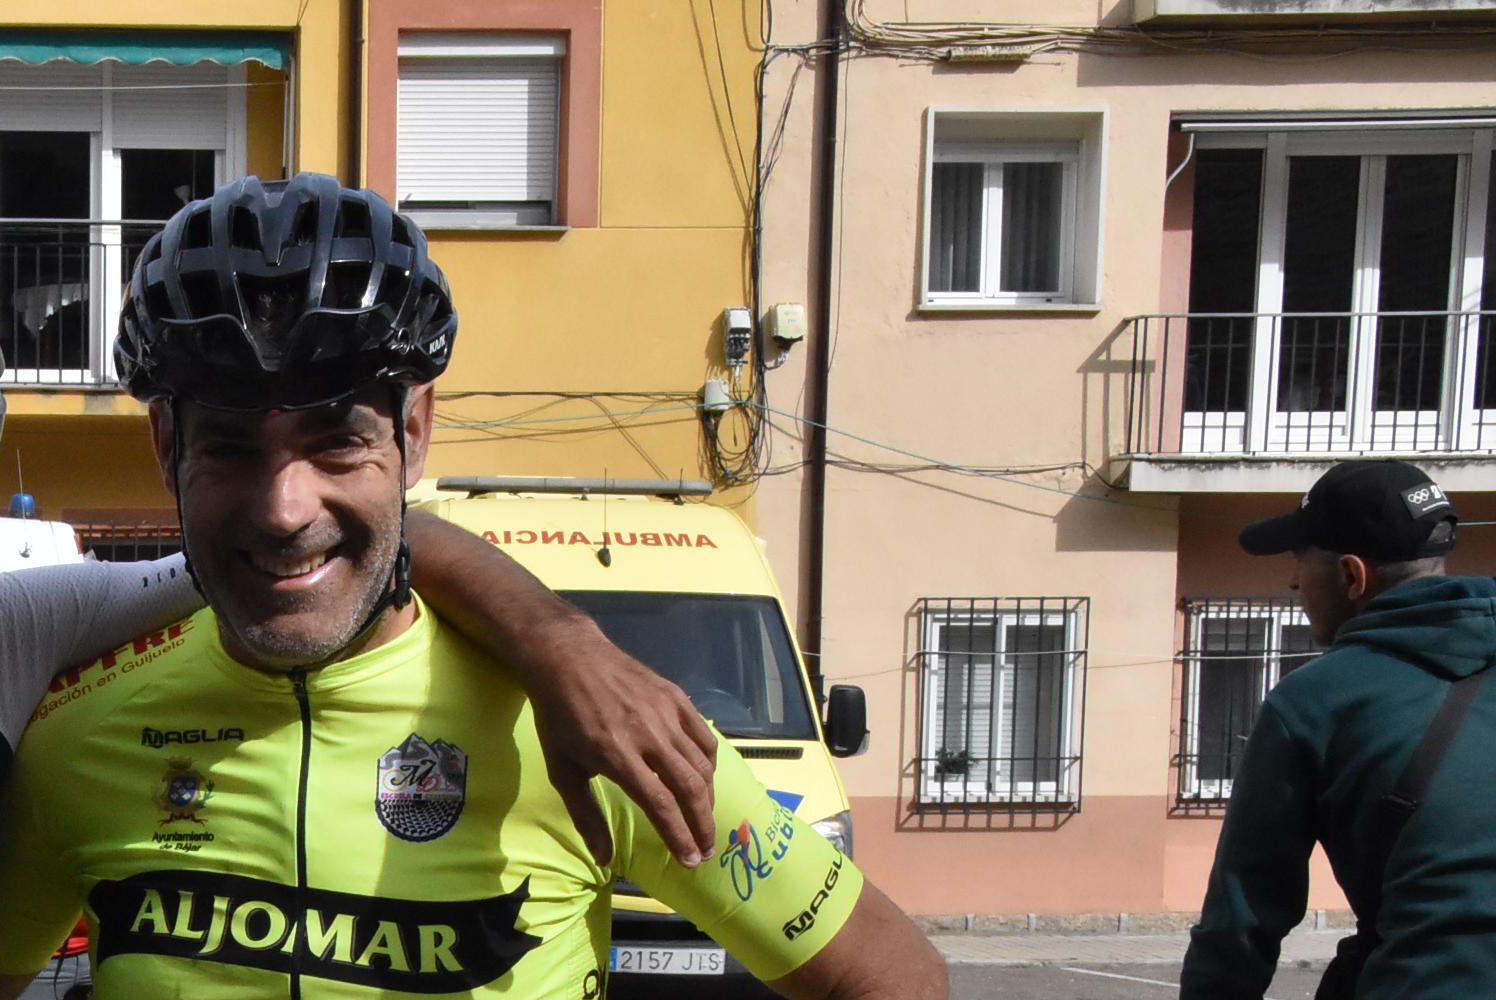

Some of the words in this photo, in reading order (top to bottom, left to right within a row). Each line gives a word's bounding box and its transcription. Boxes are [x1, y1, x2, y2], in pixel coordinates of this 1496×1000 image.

[96, 672, 117, 687] en
[121, 638, 186, 674] Guijuelo
[141, 727, 245, 749] MAGLIA
[152, 832, 215, 843] Ayuntamiento
[129, 888, 466, 974] ALJOMAR
[621, 951, 673, 970] 2157
[682, 952, 720, 971] JTS
